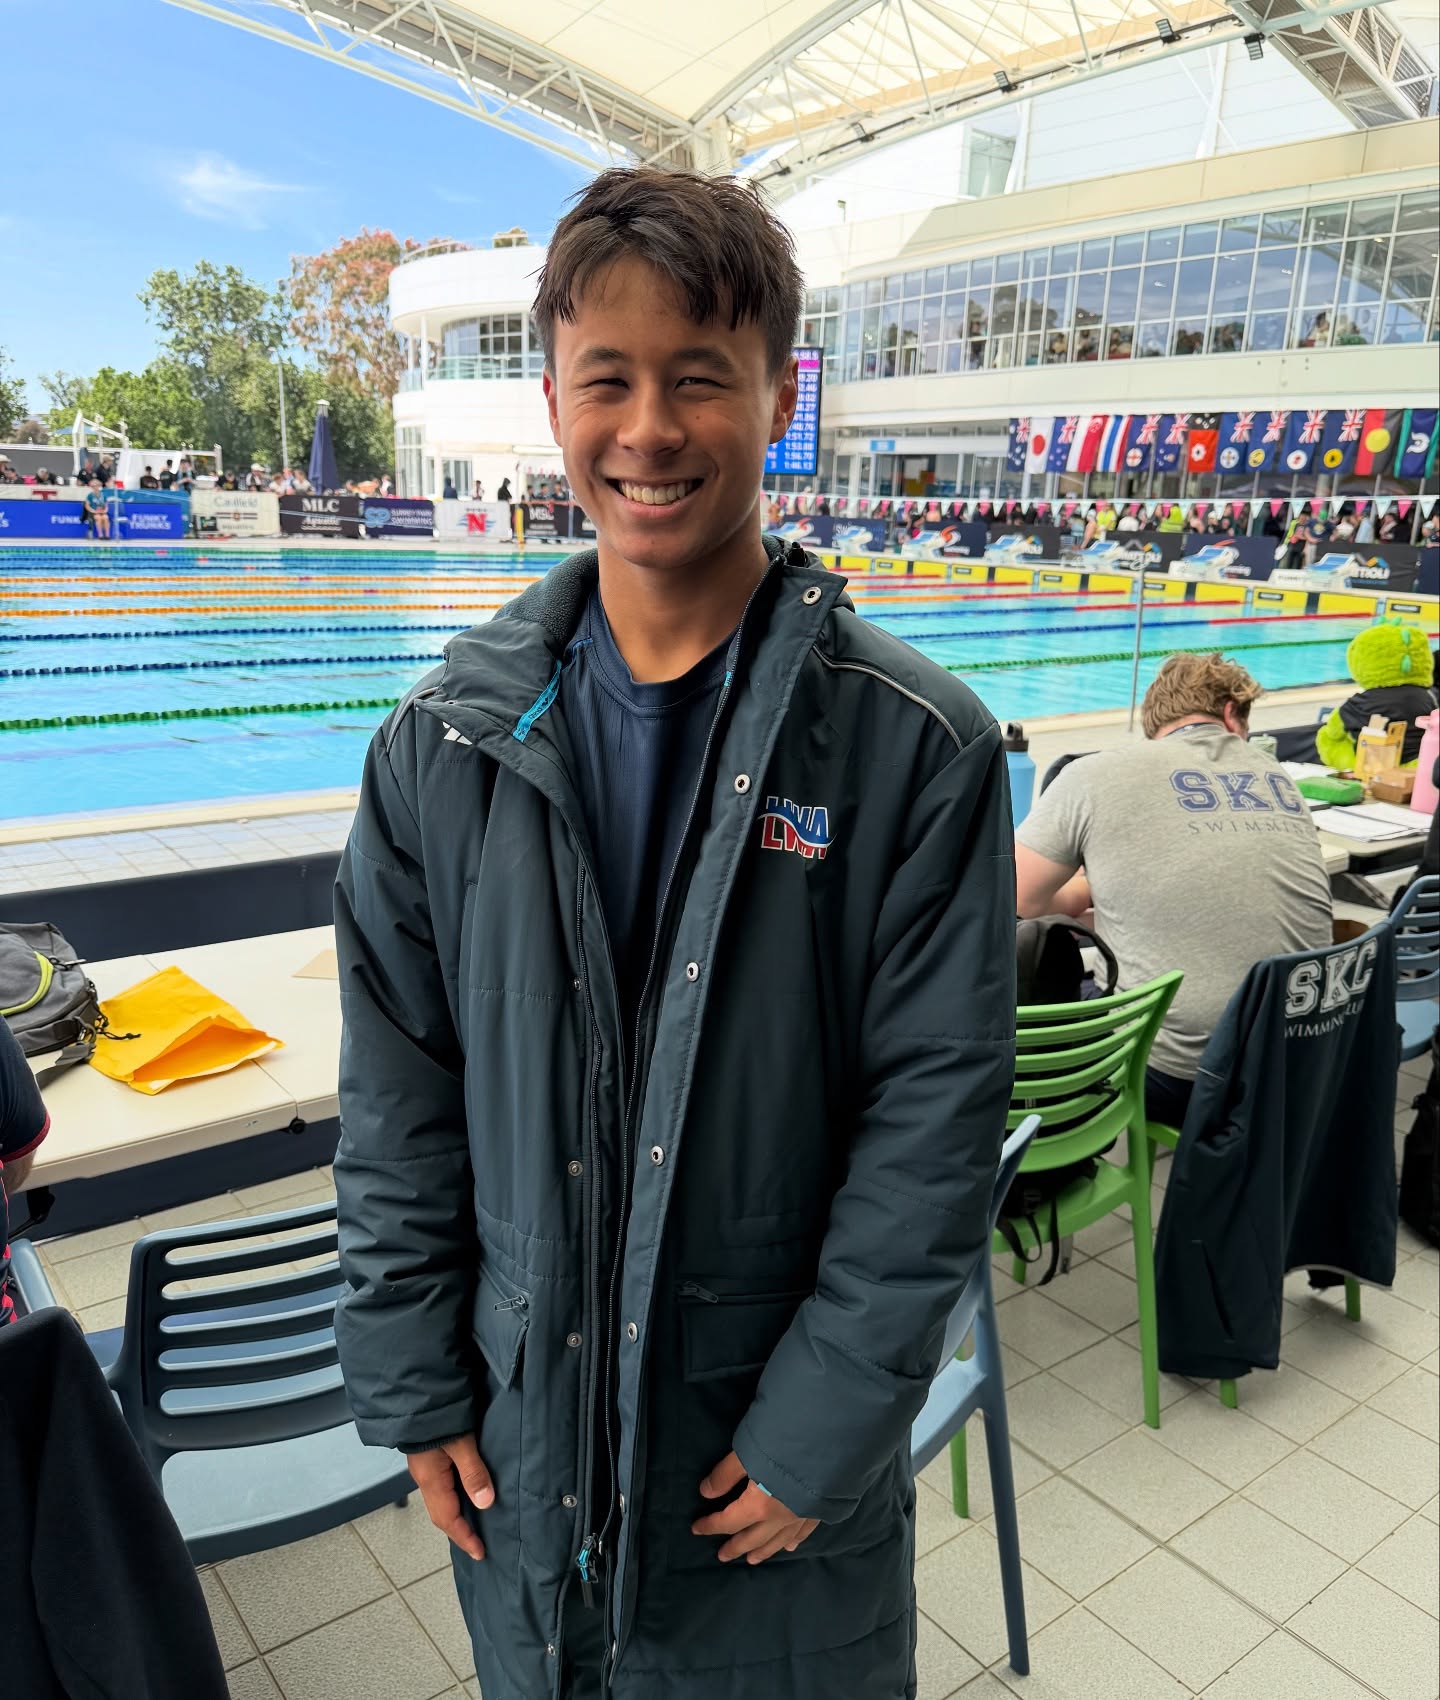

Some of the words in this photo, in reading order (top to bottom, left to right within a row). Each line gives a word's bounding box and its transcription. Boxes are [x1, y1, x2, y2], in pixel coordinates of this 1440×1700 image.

[302, 498, 340, 512] MLC
[130, 521, 171, 529] TRUNKS
[467, 513, 487, 533] N
[1169, 769, 1303, 816] SKC
[1188, 820, 1305, 834] SWIMMIN
[1285, 937, 1378, 1018] SKC
